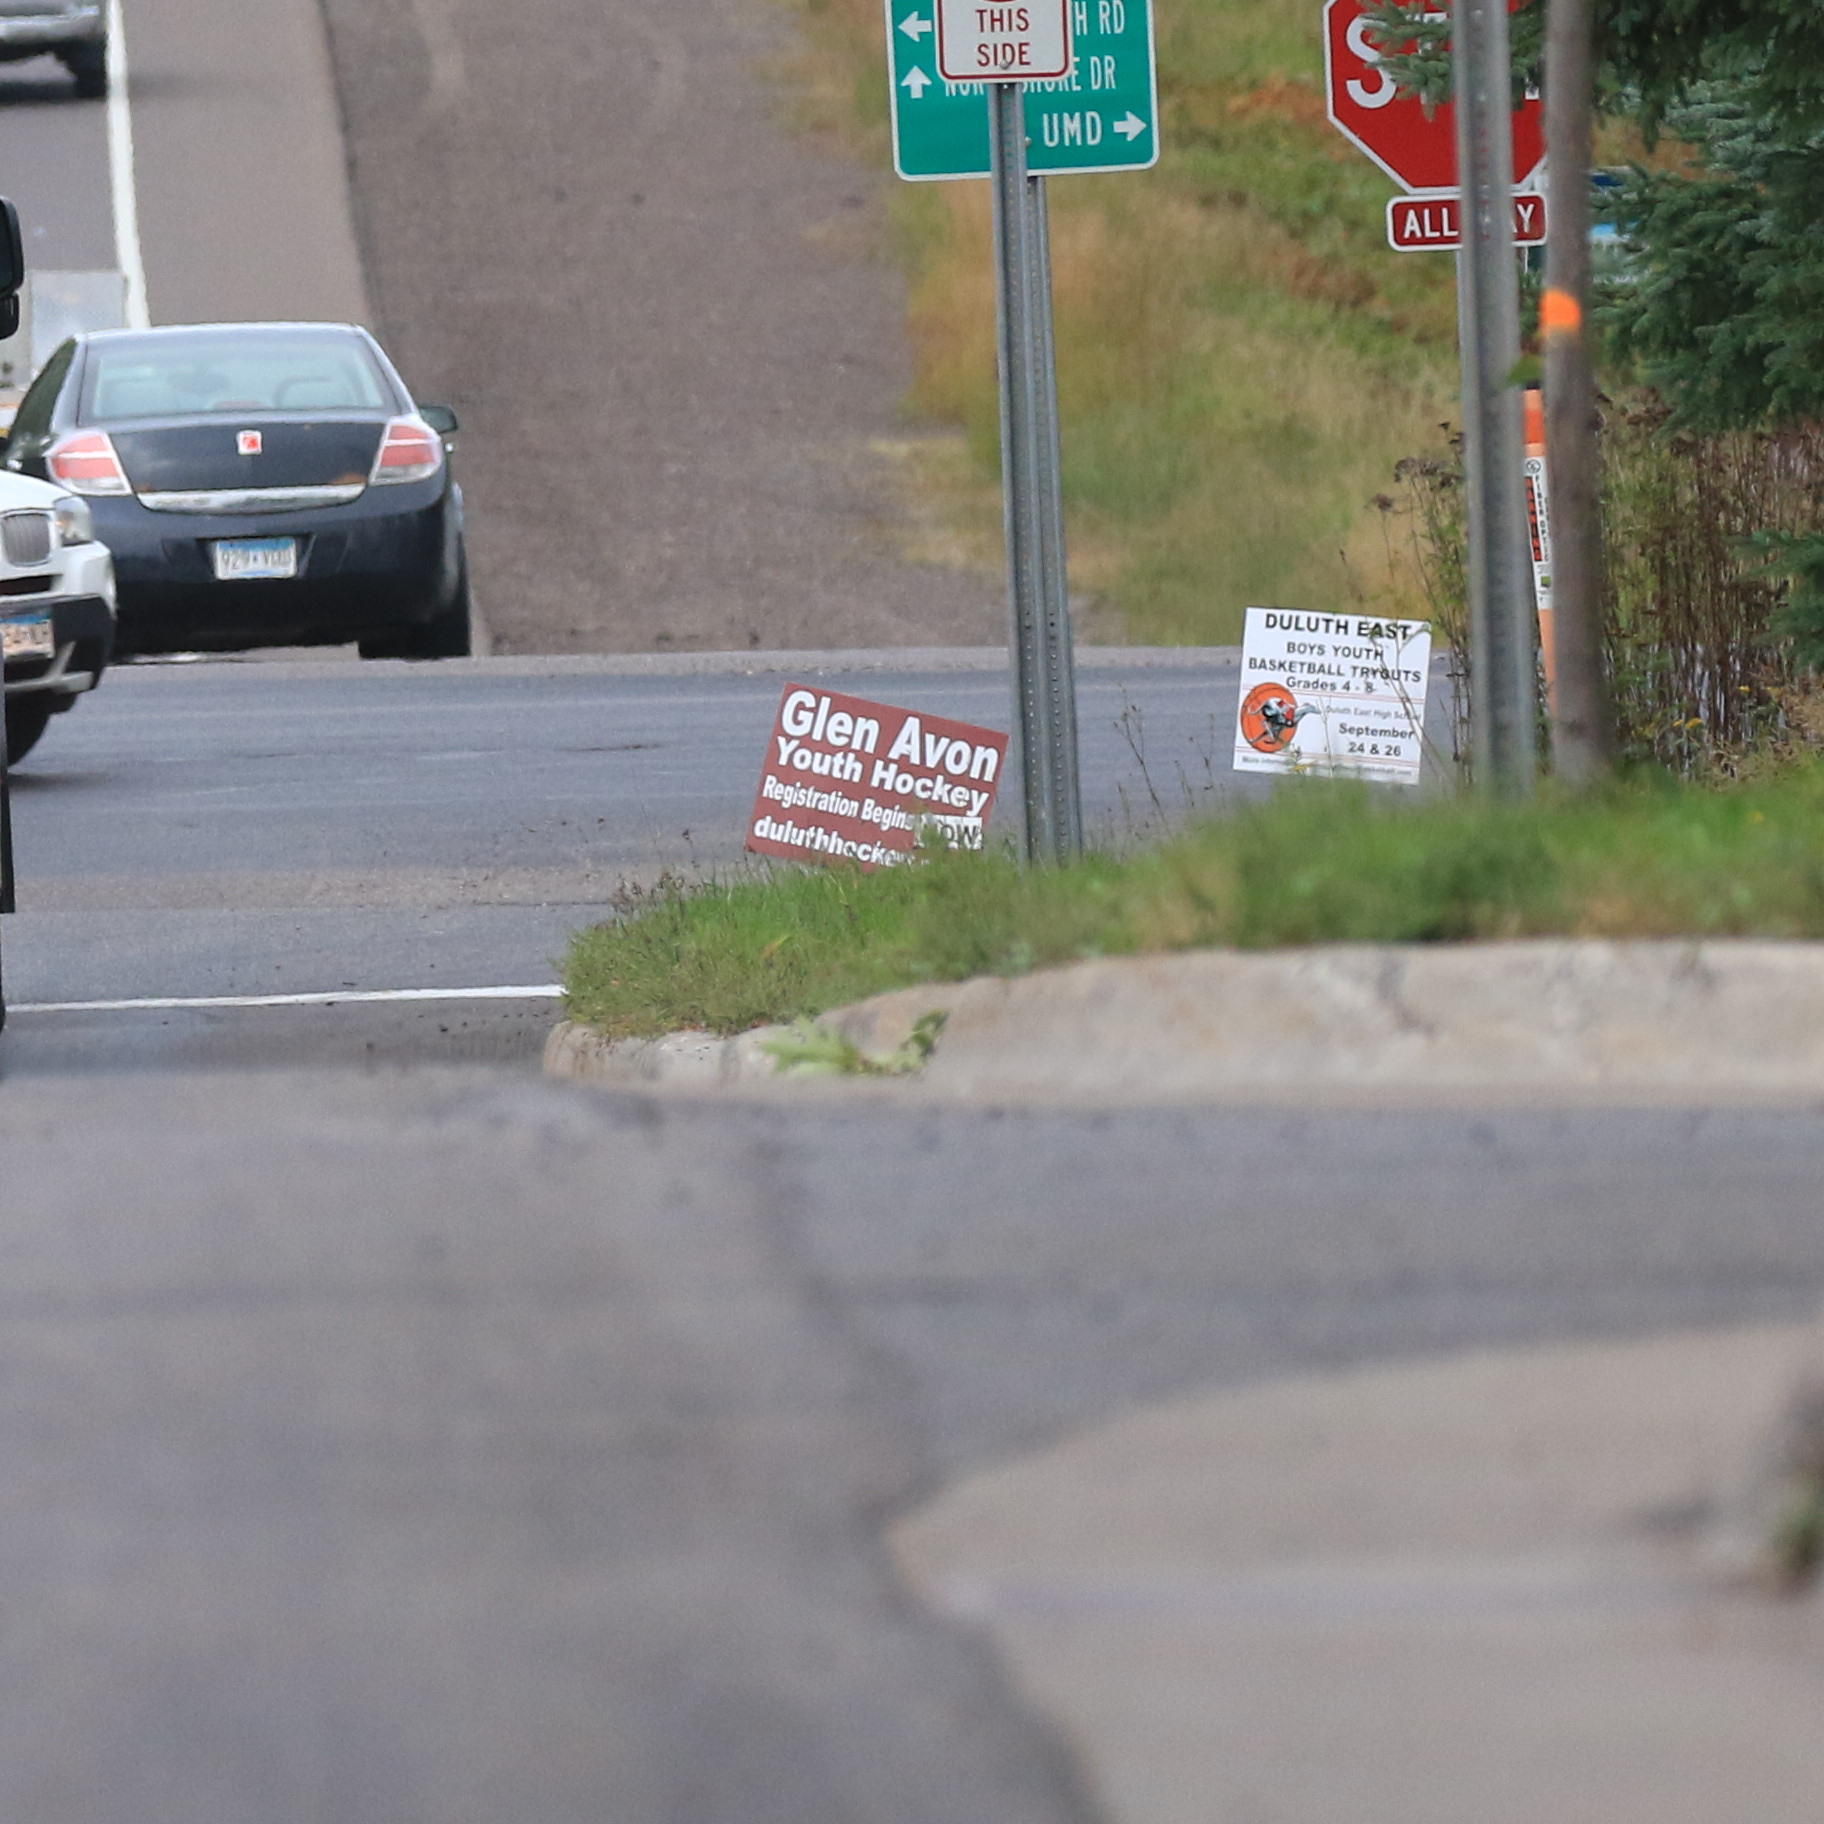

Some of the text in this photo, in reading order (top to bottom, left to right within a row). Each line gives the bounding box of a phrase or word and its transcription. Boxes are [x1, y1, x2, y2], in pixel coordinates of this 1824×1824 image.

[976, 8, 1030, 33] THIS
[1099, 0, 1125, 34] RD
[977, 42, 1032, 67] SIDE
[1091, 55, 1117, 90] DR
[1042, 111, 1103, 148] UMD
[1404, 207, 1459, 239] ALL
[1265, 613, 1412, 640] DULUTH EAST
[1287, 642, 1384, 661] BOYS YOUTH
[1249, 657, 1422, 683] BASKETBALL TRYOUTS
[1286, 677, 1337, 692] Grades
[1342, 681, 1351, 692] 4
[1365, 682, 1374, 693] 8
[781, 690, 1000, 782] Glen Avon
[1339, 722, 1415, 739] September
[1348, 741, 1402, 757] 24 & 26
[777, 736, 990, 817] Youth Hockey
[763, 775, 860, 818] Registration
[861, 798, 915, 832] Begins
